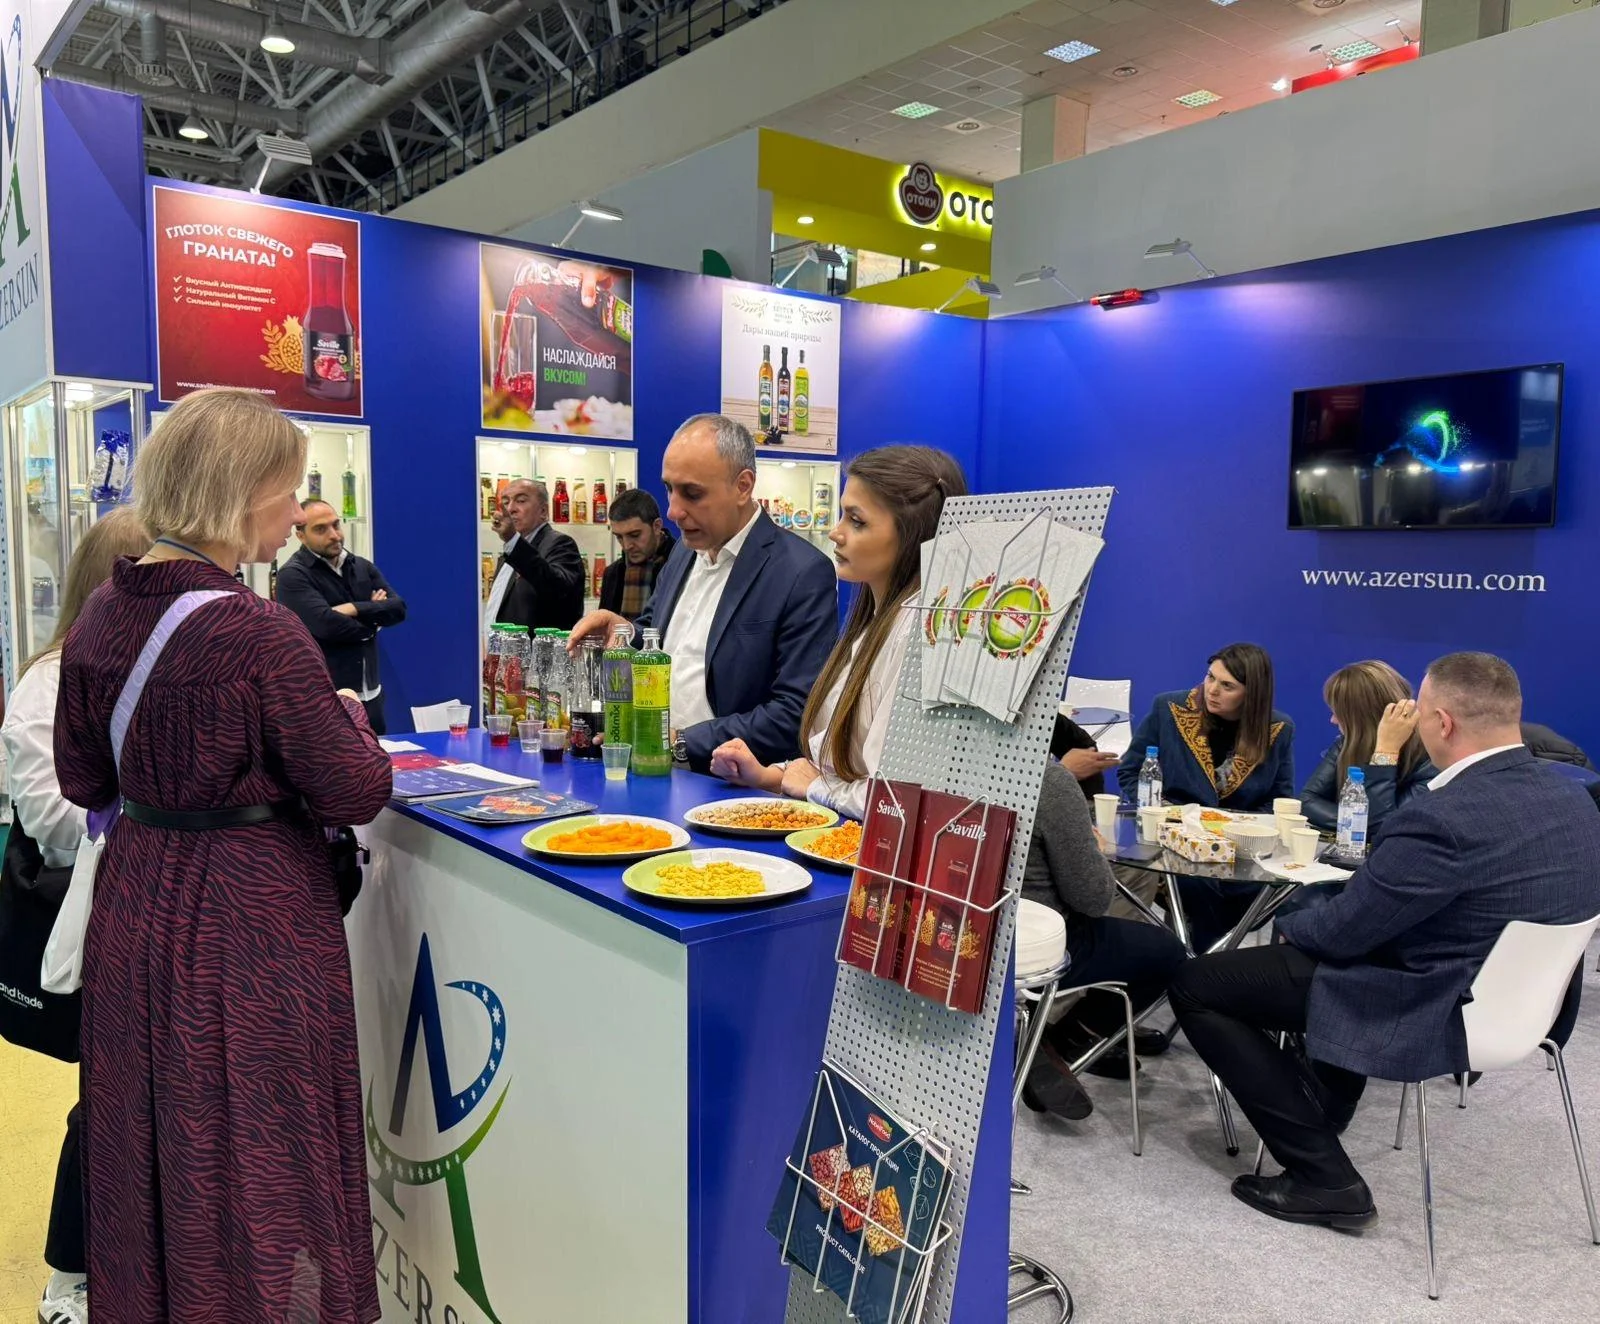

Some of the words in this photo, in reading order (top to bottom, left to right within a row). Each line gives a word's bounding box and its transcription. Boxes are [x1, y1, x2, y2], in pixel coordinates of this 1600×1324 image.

[165, 224, 224, 239] ГЛОТОК
[226, 226, 294, 258] СВЕЖЕГО
[183, 240, 276, 268] ГРАНАТА!
[185, 277, 219, 287] Вкусный
[220, 281, 272, 294] Антиоксидант
[185, 286, 236, 299] Натуральный
[237, 293, 269, 304] Витамин
[185, 297, 221, 307] Сильный
[543, 347, 616, 370] НАСЛАЖДАЙСЯ
[544, 367, 587, 386] ВКУСОМ!
[1301, 569, 1547, 592] www.azersun.com
[876, 799, 905, 818] Saville
[946, 820, 987, 841] Saville
[17, 989, 44, 1010] trade
[848, 1125, 871, 1147] КАТАЛОГ
[815, 1223, 839, 1248] PROUCT
[837, 1244, 866, 1275] CATALOUE
